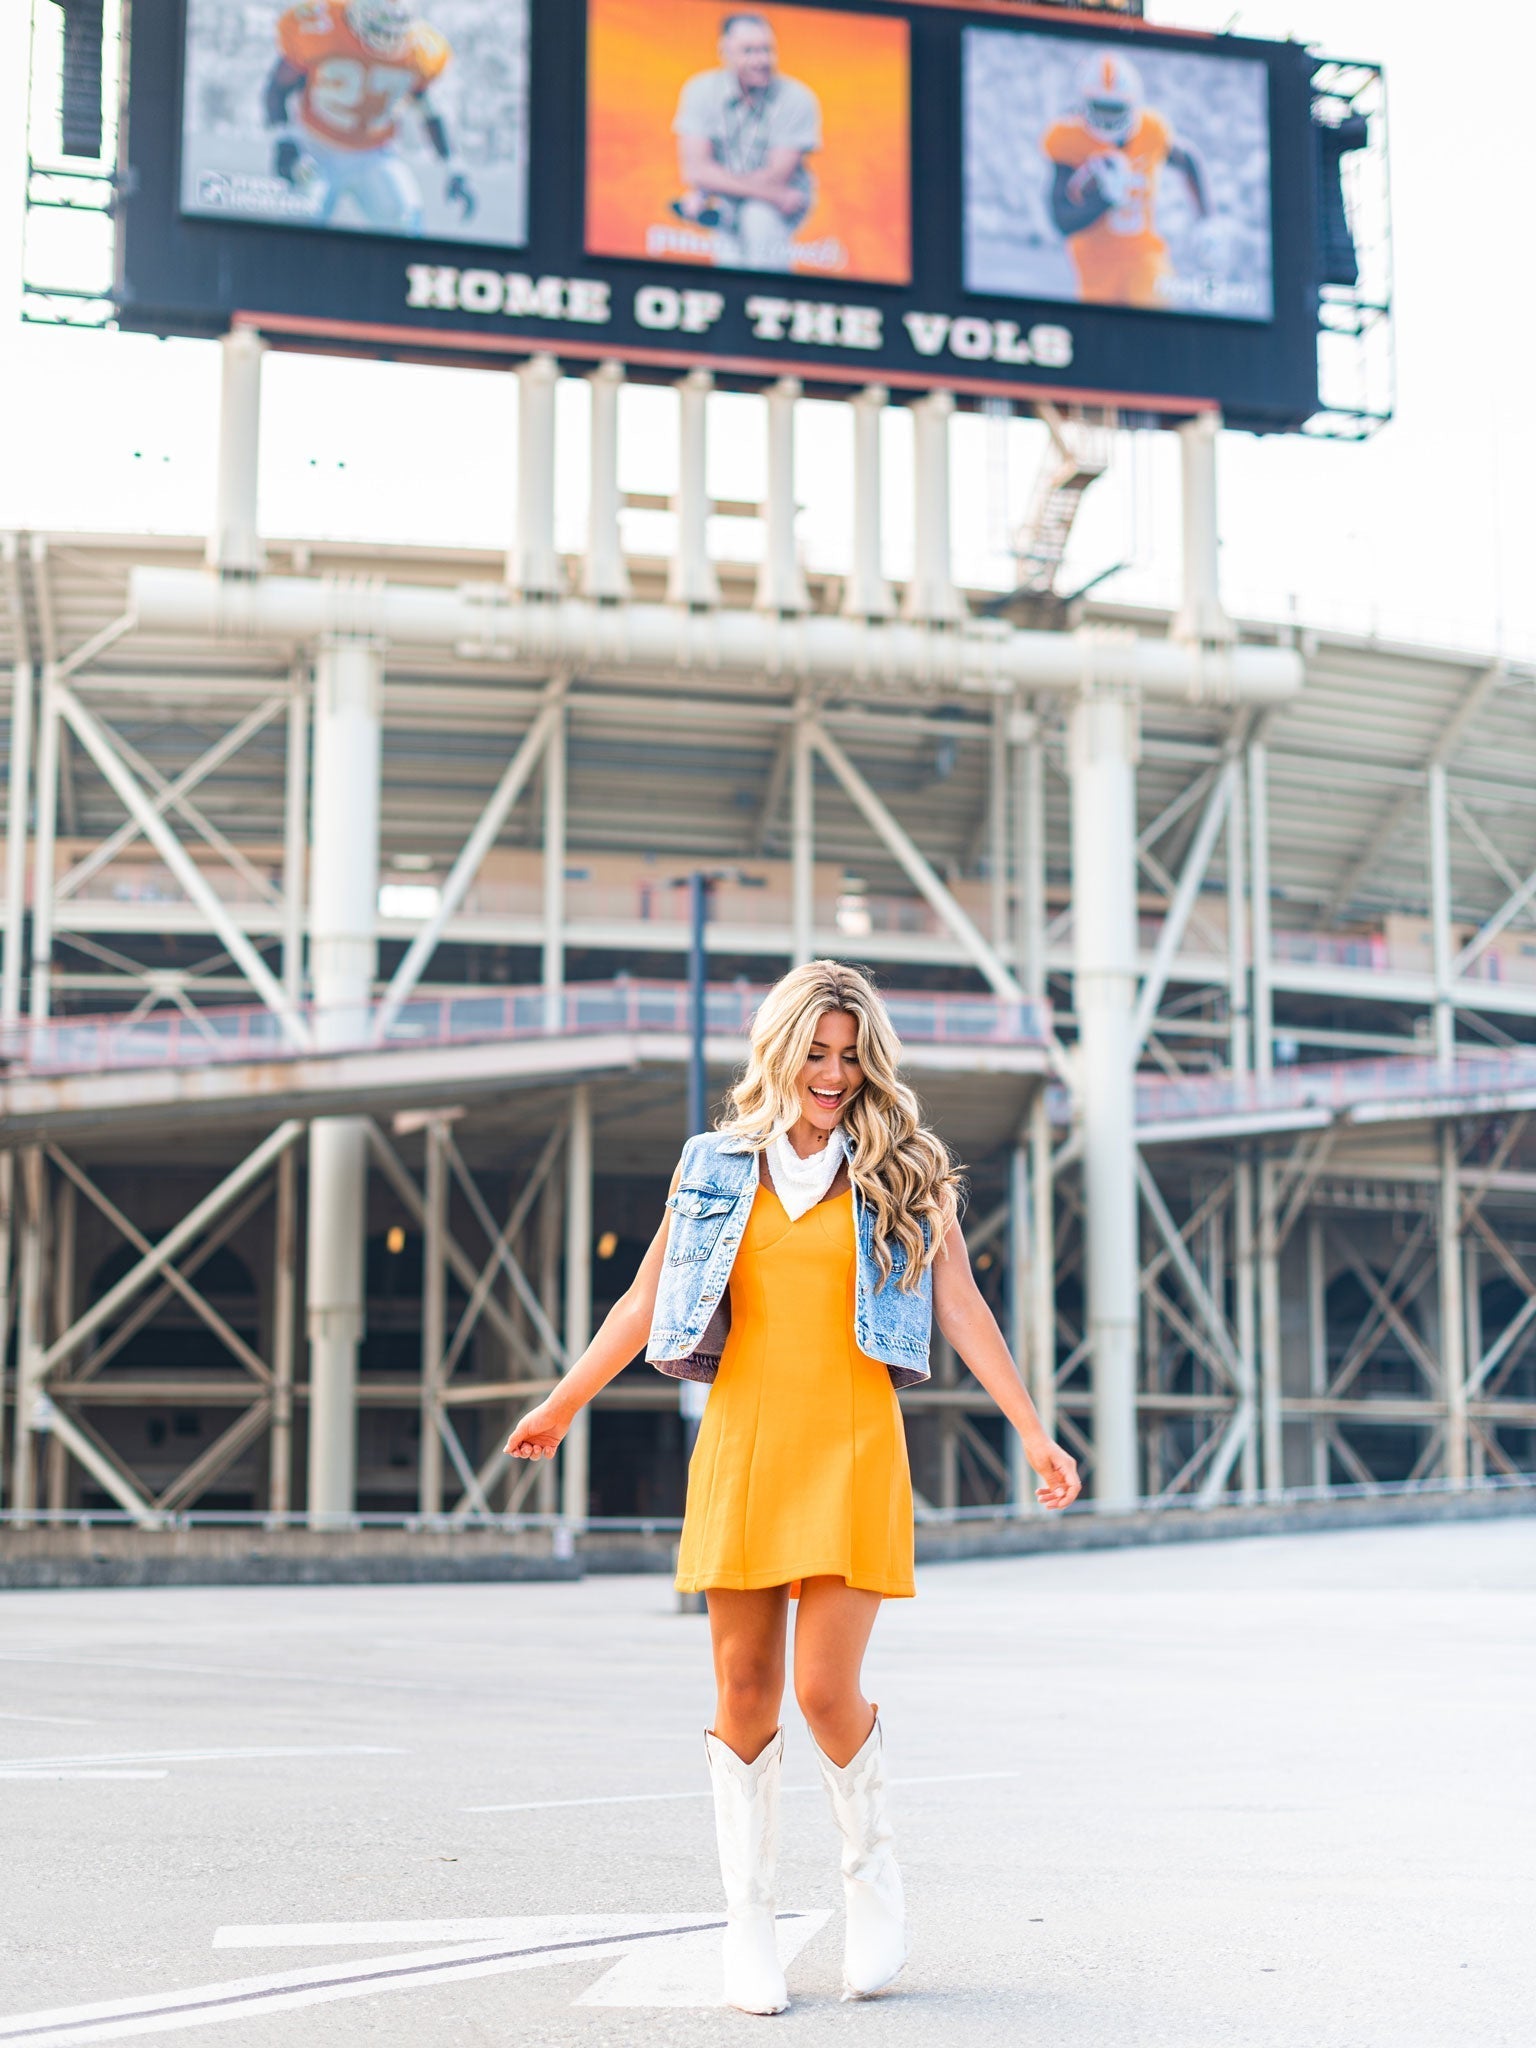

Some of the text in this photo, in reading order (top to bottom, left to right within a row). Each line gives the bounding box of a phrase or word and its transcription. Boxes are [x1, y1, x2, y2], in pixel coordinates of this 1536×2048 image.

[309, 56, 413, 134] 27
[406, 262, 1074, 369] HOME OF THE VOLS
